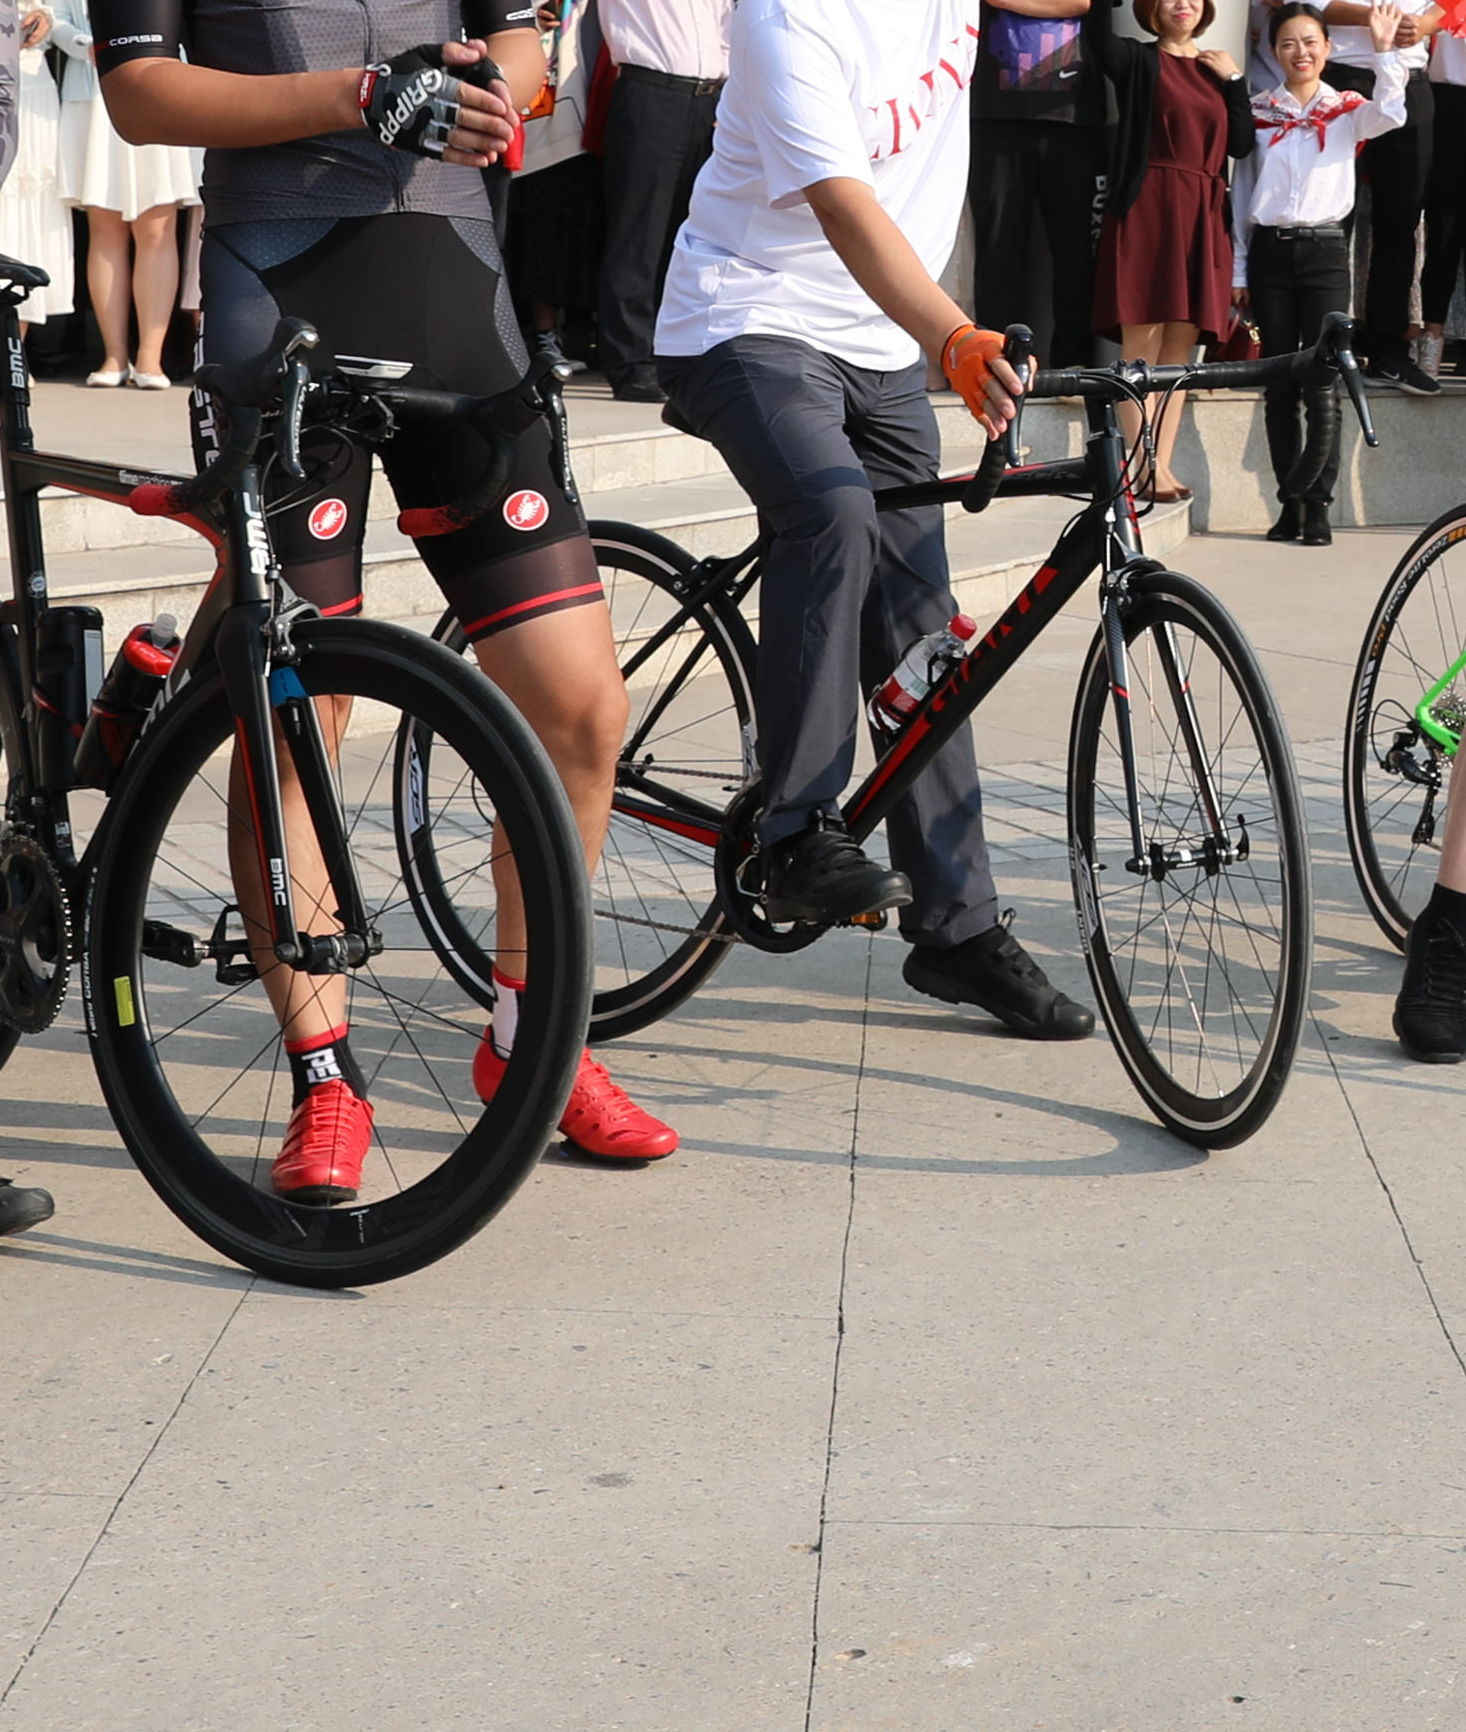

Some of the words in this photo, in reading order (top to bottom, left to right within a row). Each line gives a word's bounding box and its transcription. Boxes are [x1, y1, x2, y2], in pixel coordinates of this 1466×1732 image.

[109, 34, 164, 47] CORSA
[9, 337, 26, 389] BMC
[269, 857, 287, 906] BMC
